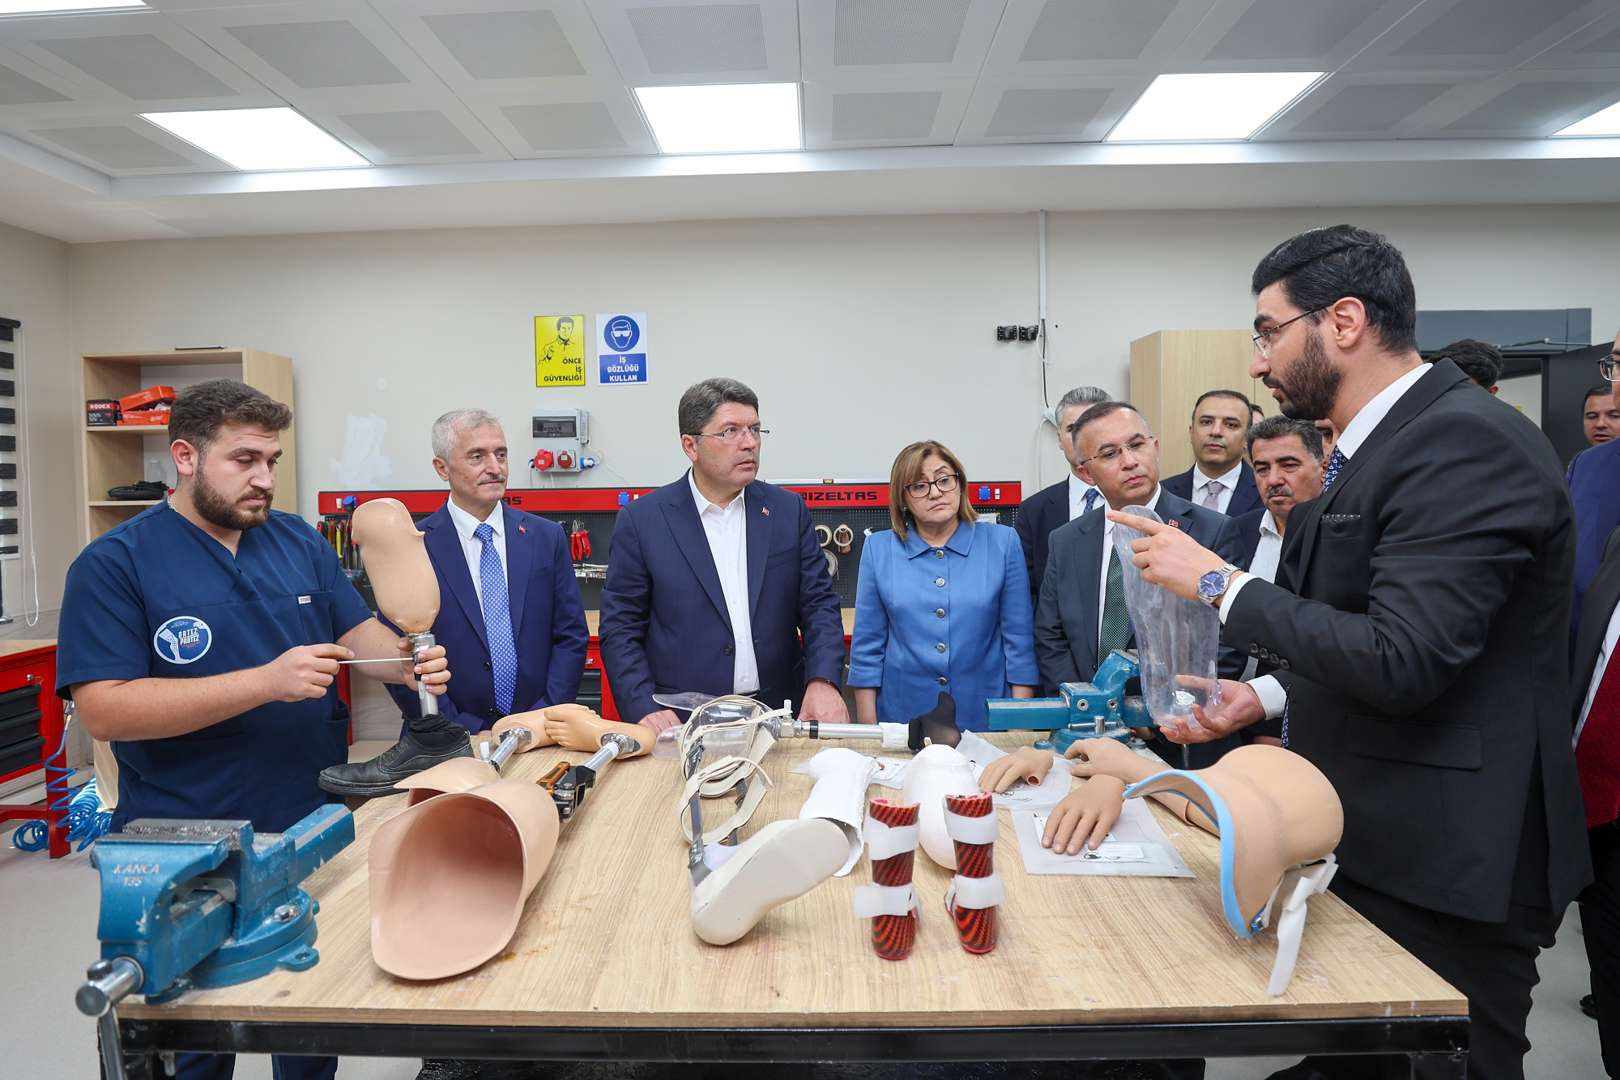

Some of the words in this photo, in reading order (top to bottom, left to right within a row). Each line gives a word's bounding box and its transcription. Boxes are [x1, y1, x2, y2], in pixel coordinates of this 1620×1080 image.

[562, 356, 581, 364] ÖNCE
[607, 364, 640, 373] GÖZLÜĞÜ
[609, 374, 638, 382] KULLAN
